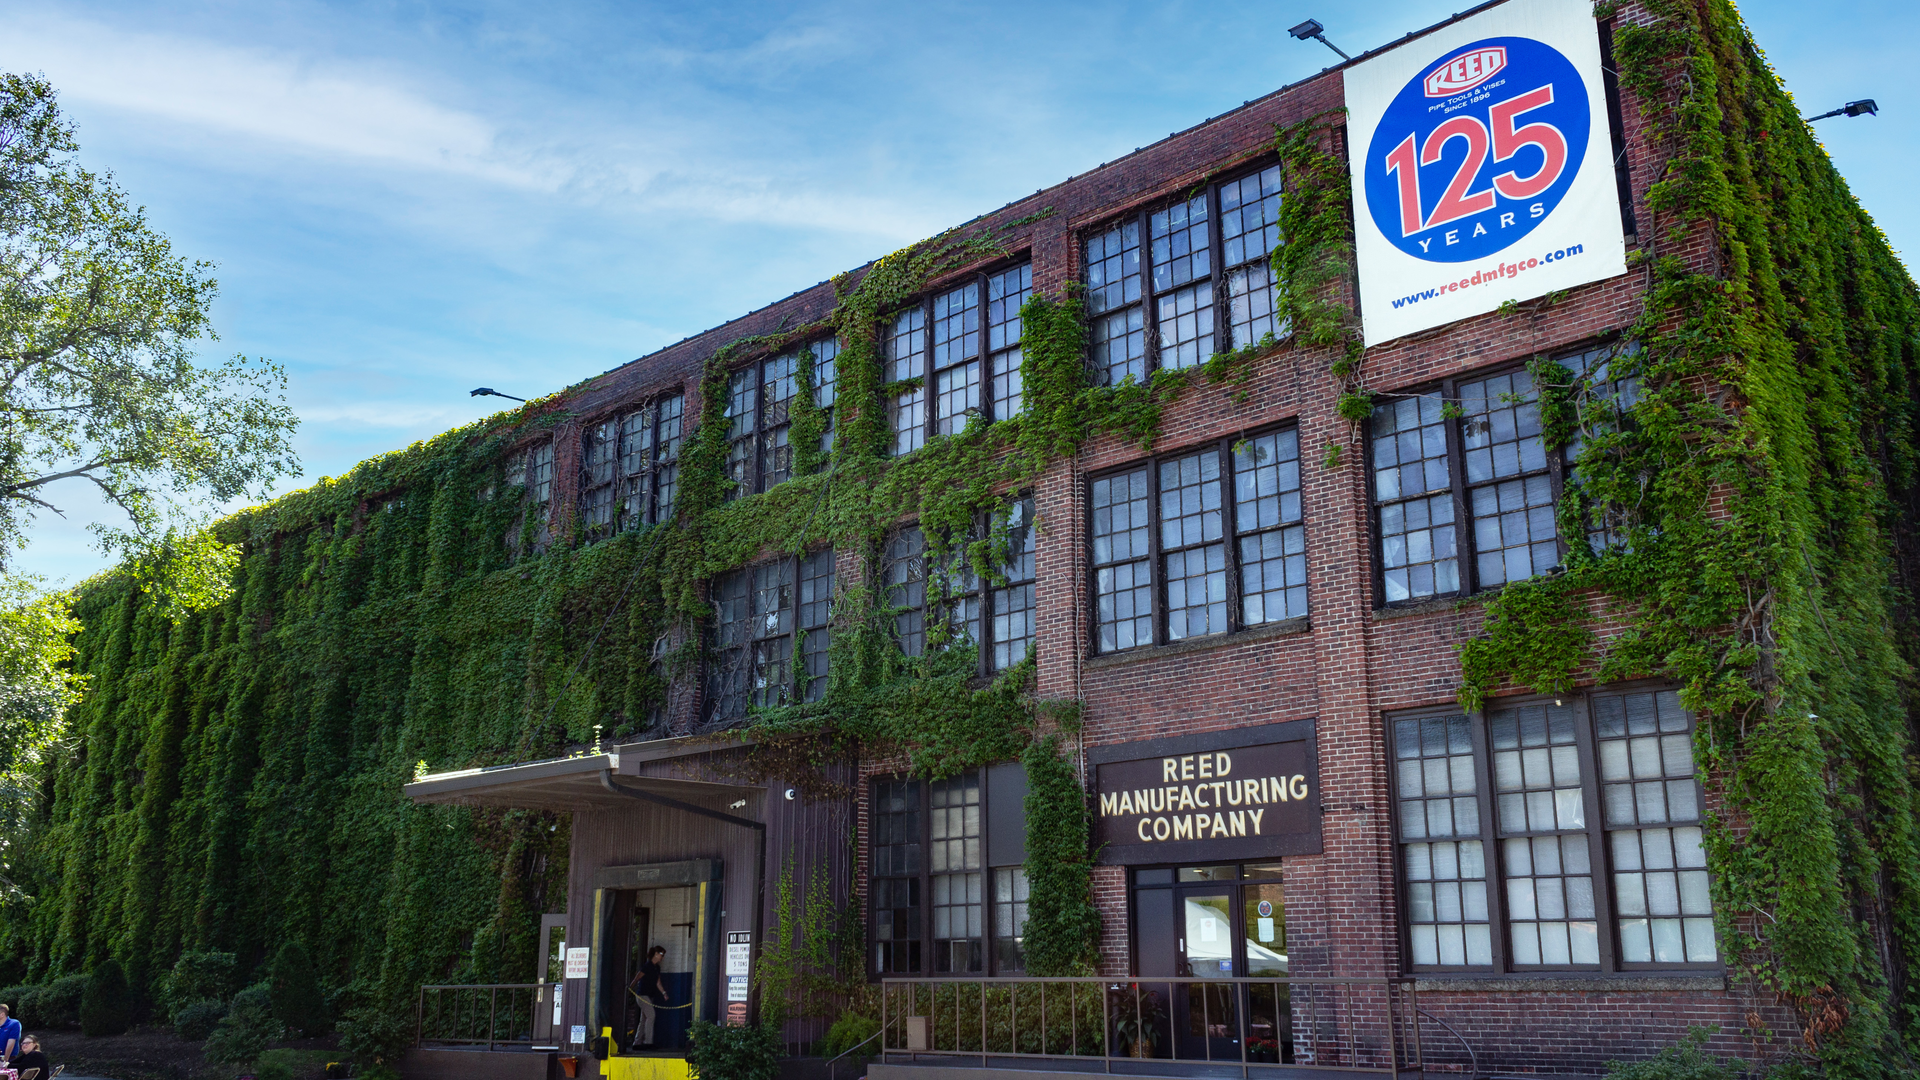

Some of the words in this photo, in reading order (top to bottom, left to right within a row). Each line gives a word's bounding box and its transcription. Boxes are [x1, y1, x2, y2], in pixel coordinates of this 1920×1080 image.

[1429, 51, 1503, 94] REED
[1428, 102, 1446, 113] PIPE
[1447, 91, 1473, 105] TOOLS
[1482, 79, 1506, 91] VISES
[1444, 101, 1468, 114] SINCE
[1470, 92, 1491, 104] 1896
[1385, 83, 1569, 238] 125
[1418, 202, 1545, 254] YEARS
[1391, 242, 1585, 310] www.reedmfgco.com
[1163, 752, 1232, 783] REED
[1100, 774, 1308, 817] MANUFACTURING
[1137, 808, 1265, 842] COMPANY
[730, 933, 737, 943] NO
[737, 933, 750, 943] IDLIN
